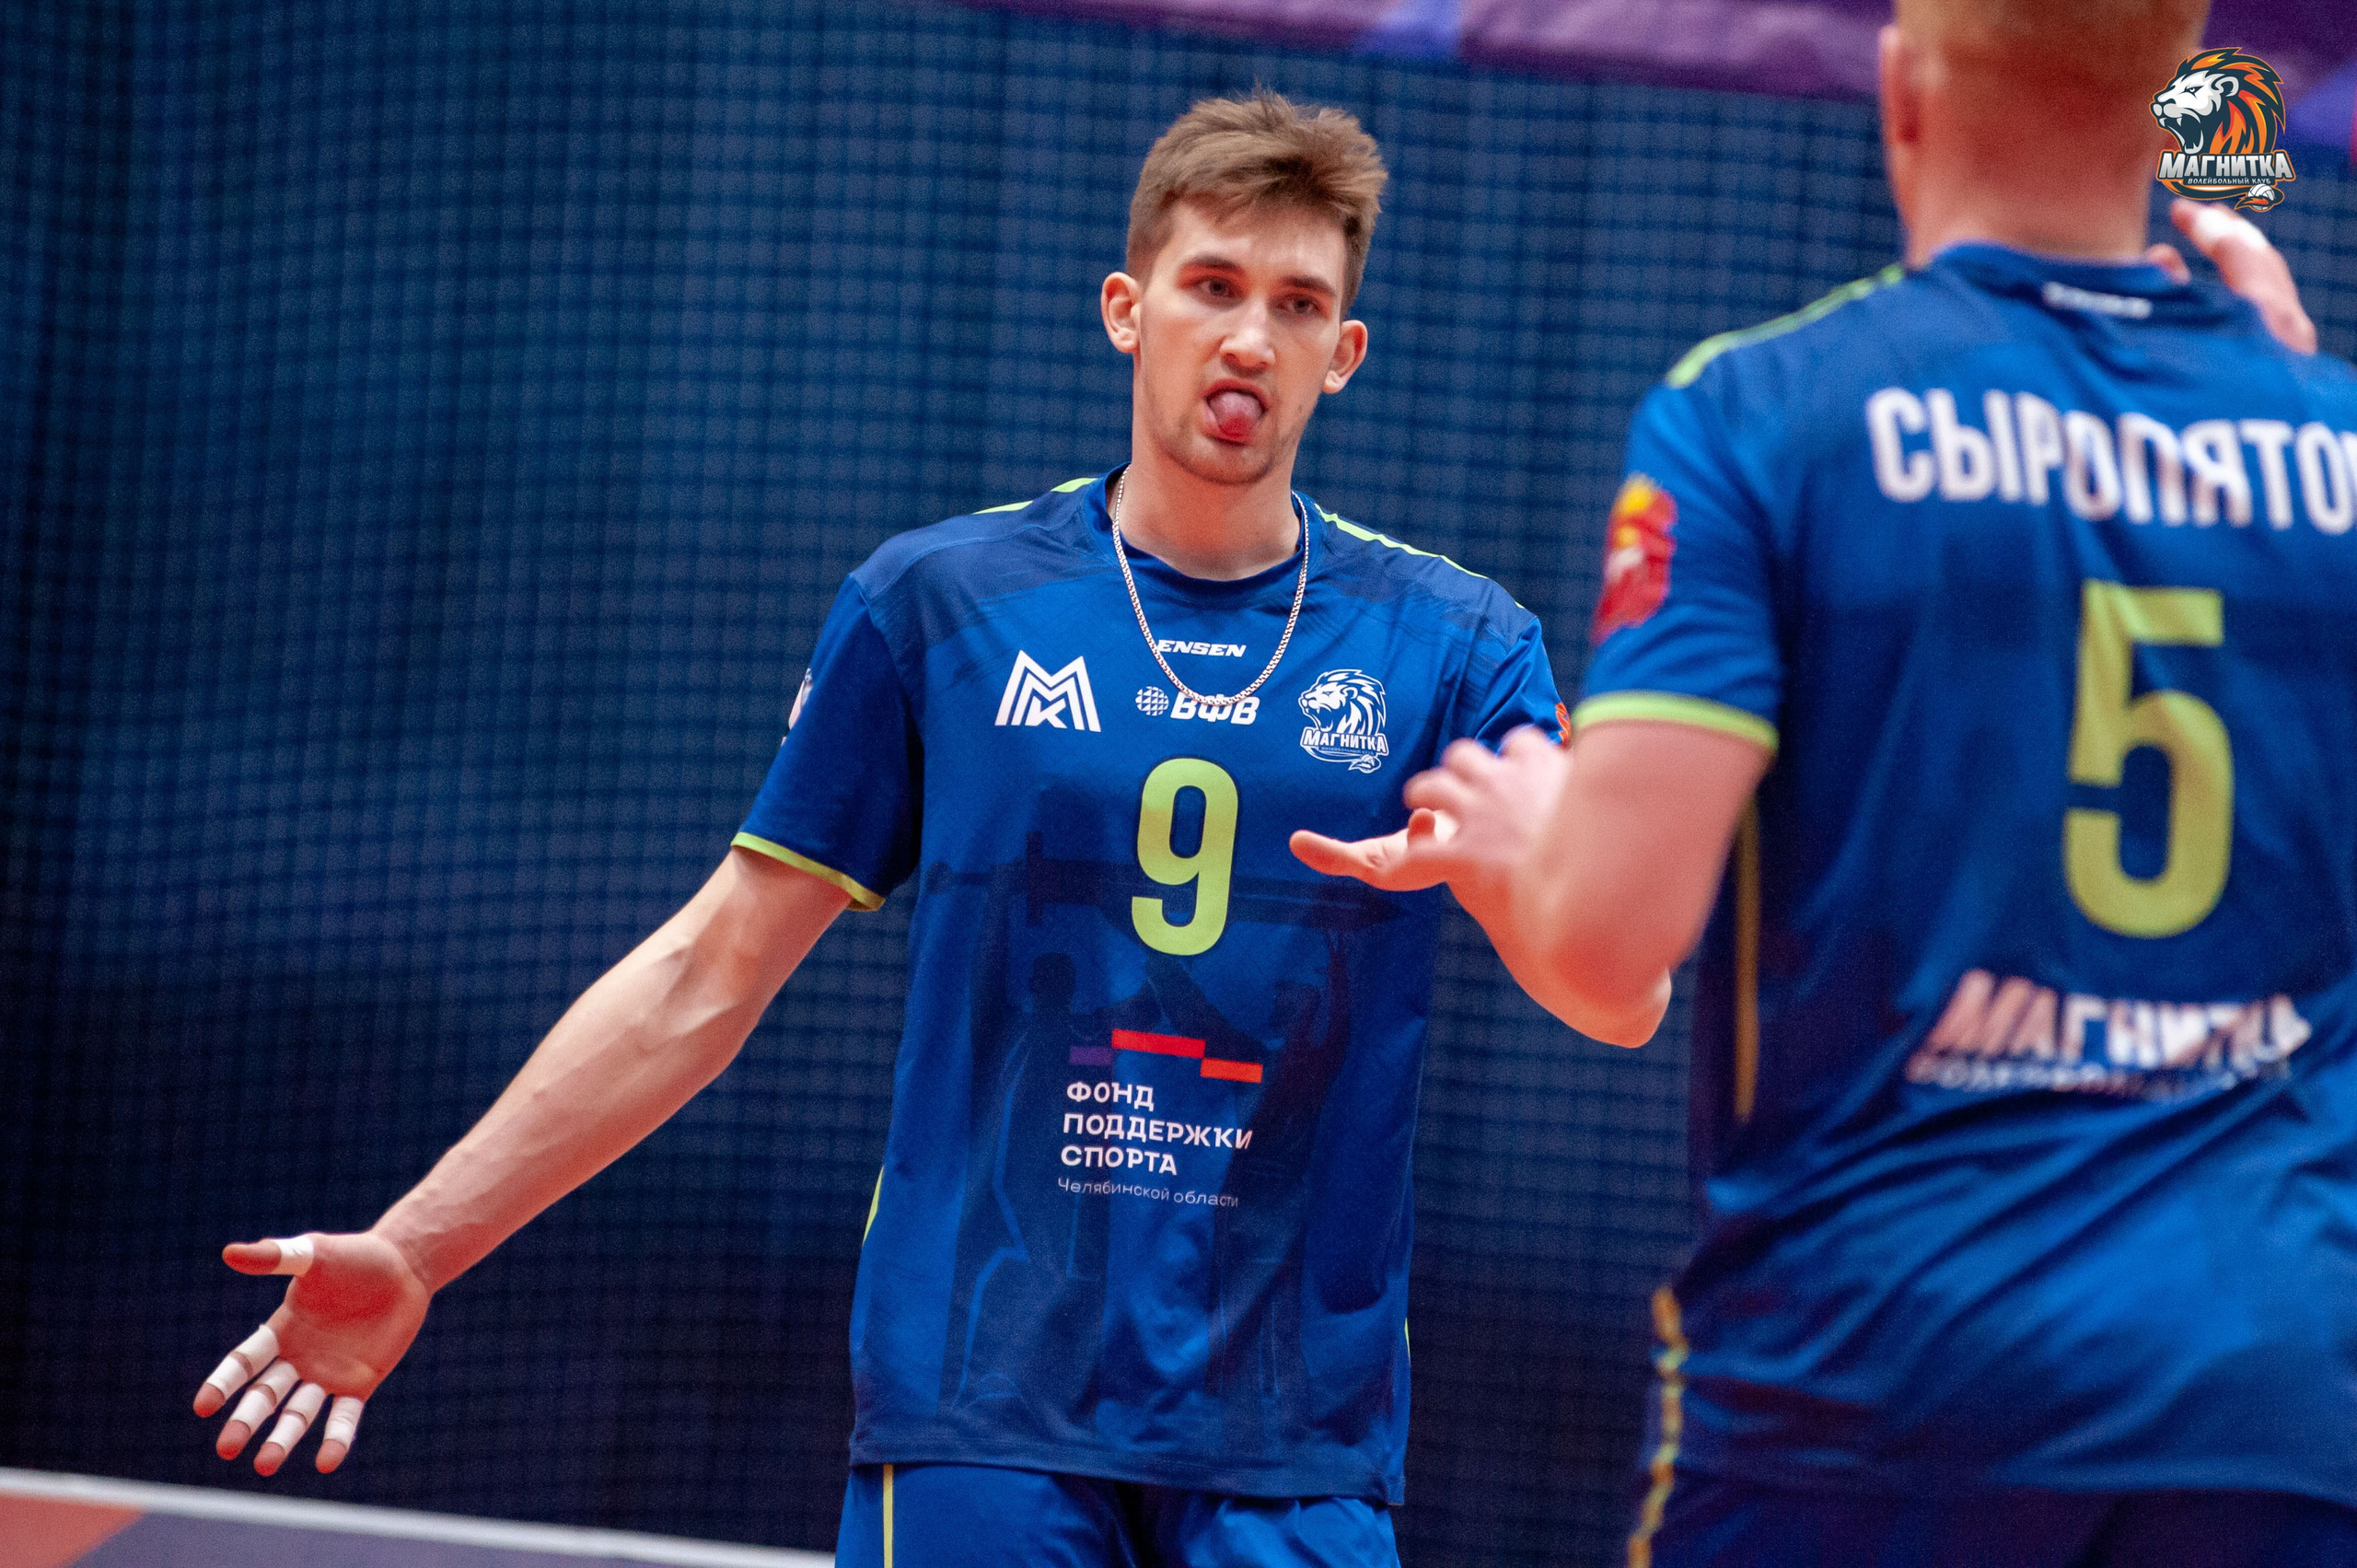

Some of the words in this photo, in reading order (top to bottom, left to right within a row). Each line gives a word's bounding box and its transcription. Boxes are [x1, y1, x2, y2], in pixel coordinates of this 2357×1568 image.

[1303, 729, 1387, 753] МАГНИТКА
[2061, 577, 2235, 939] 5
[1131, 757, 1239, 956] 9
[1065, 1080, 1155, 1112] ФОНД
[1062, 1112, 1254, 1151] ПОДДЕРЖКИ
[1060, 1144, 1178, 1177] СПОРТА
[1057, 1177, 1170, 1202] Челябинской
[1172, 1190, 1239, 1208] области
